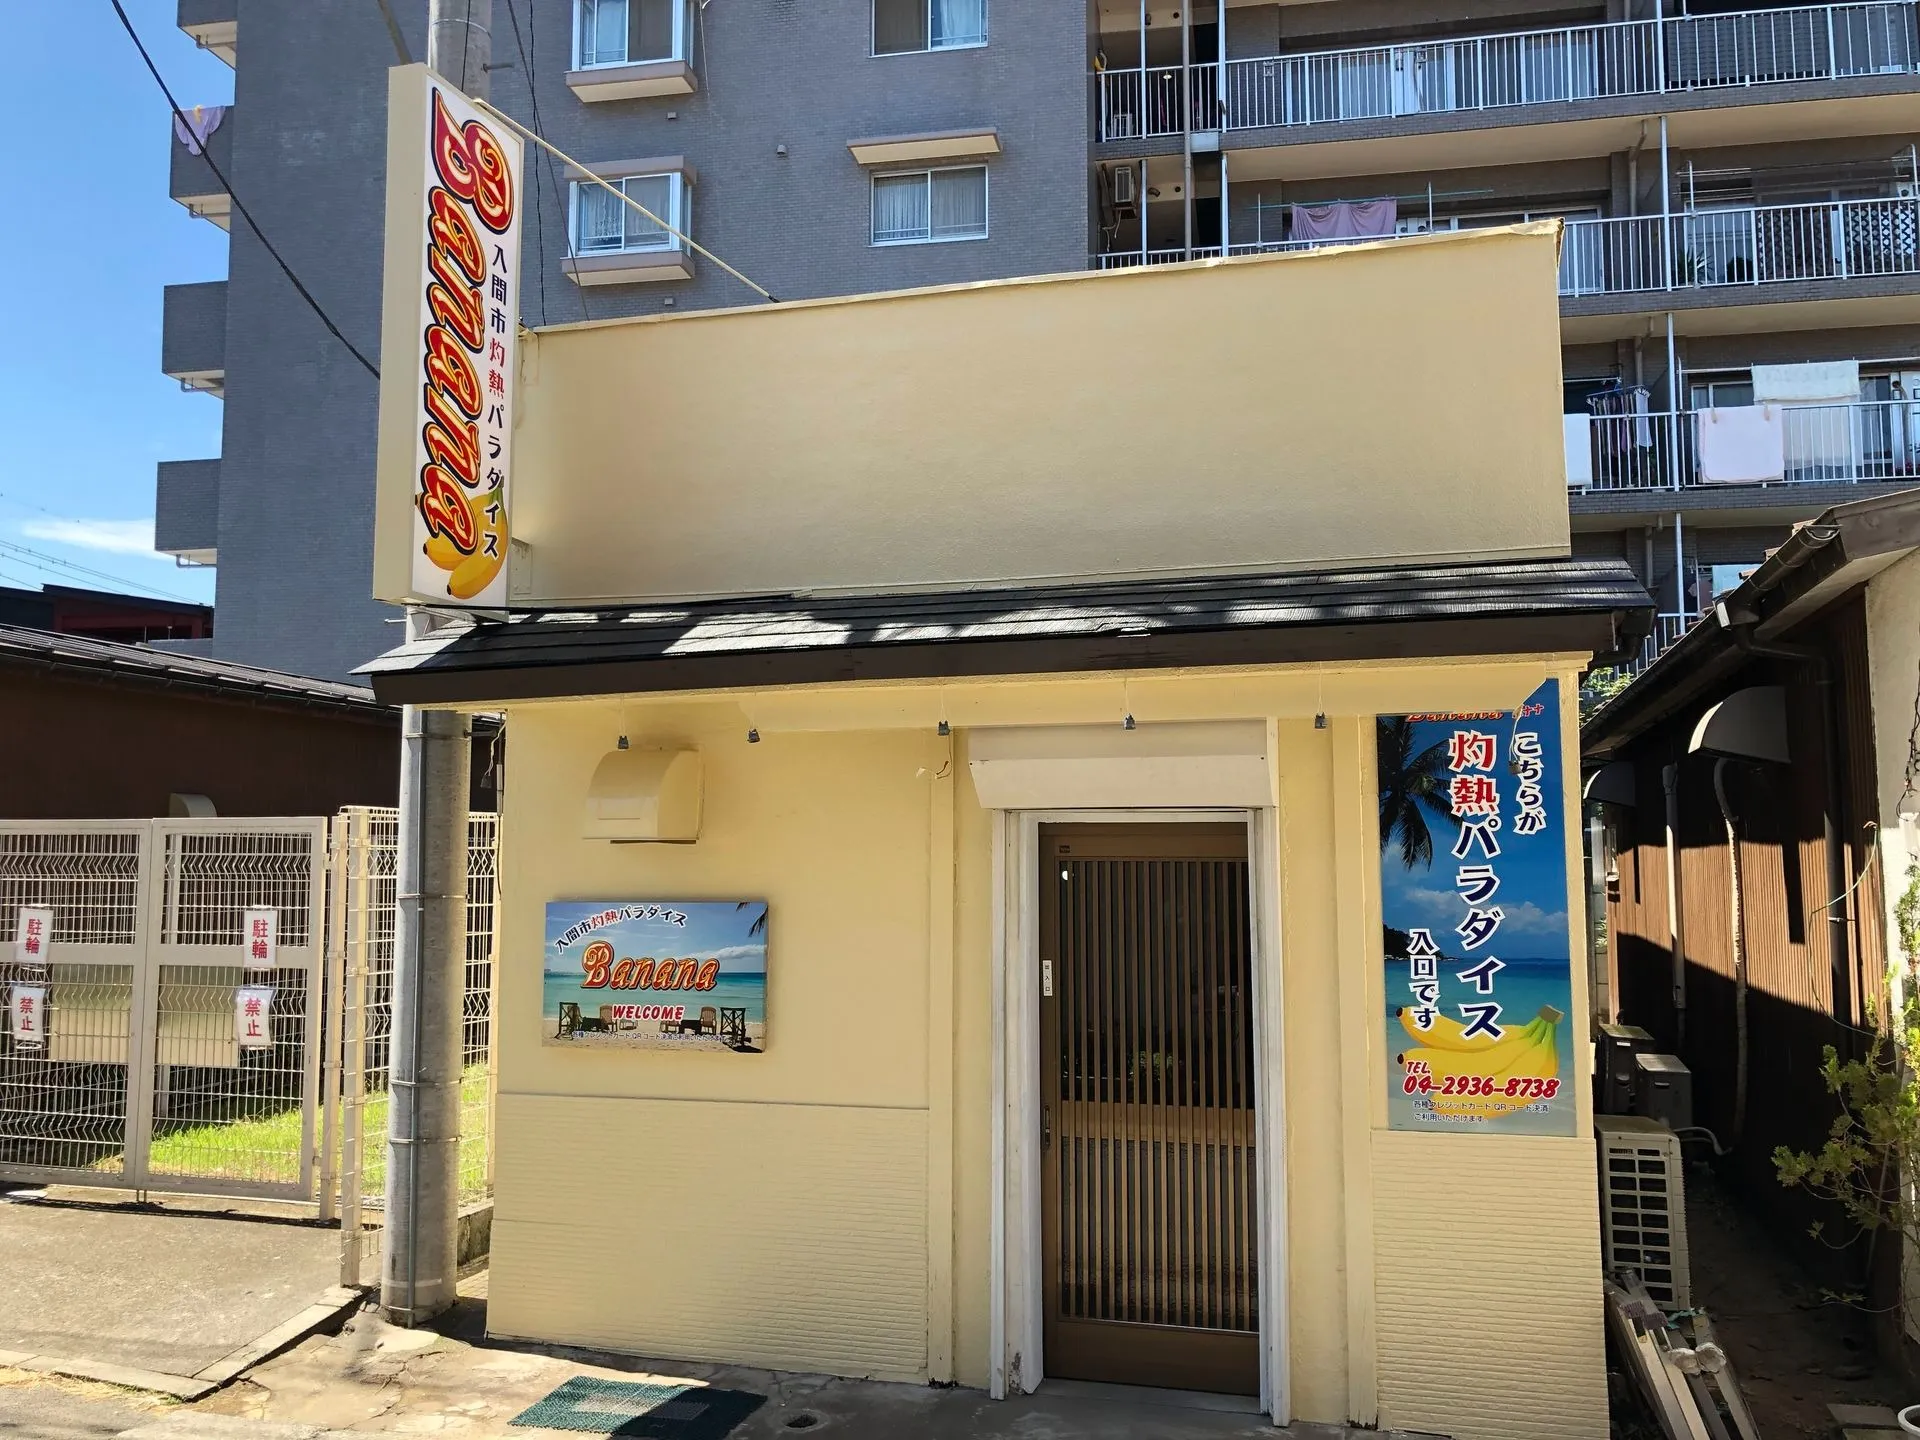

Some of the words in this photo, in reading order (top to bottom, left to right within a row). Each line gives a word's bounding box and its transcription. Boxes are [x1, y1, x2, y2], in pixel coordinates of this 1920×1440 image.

[420, 87, 514, 555] Banana
[484, 244, 507, 557] 入間市灼熱パラダイス
[1515, 733, 1545, 833] こちらが
[1450, 731, 1503, 1039] 灼熱パラダイス
[25, 919, 42, 954] 駐輪
[252, 919, 268, 959] 駐輪
[555, 906, 687, 953] 入間市灼熱パラダイス
[580, 940, 720, 991] Banana
[1409, 930, 1438, 1030] 入口です
[20, 998, 35, 1032] 禁止
[245, 998, 262, 1037] 禁止
[612, 1005, 684, 1021] WELCOME
[1404, 1076, 1560, 1098] 04-2936-8738
[1407, 1062, 1430, 1073] TEL.
